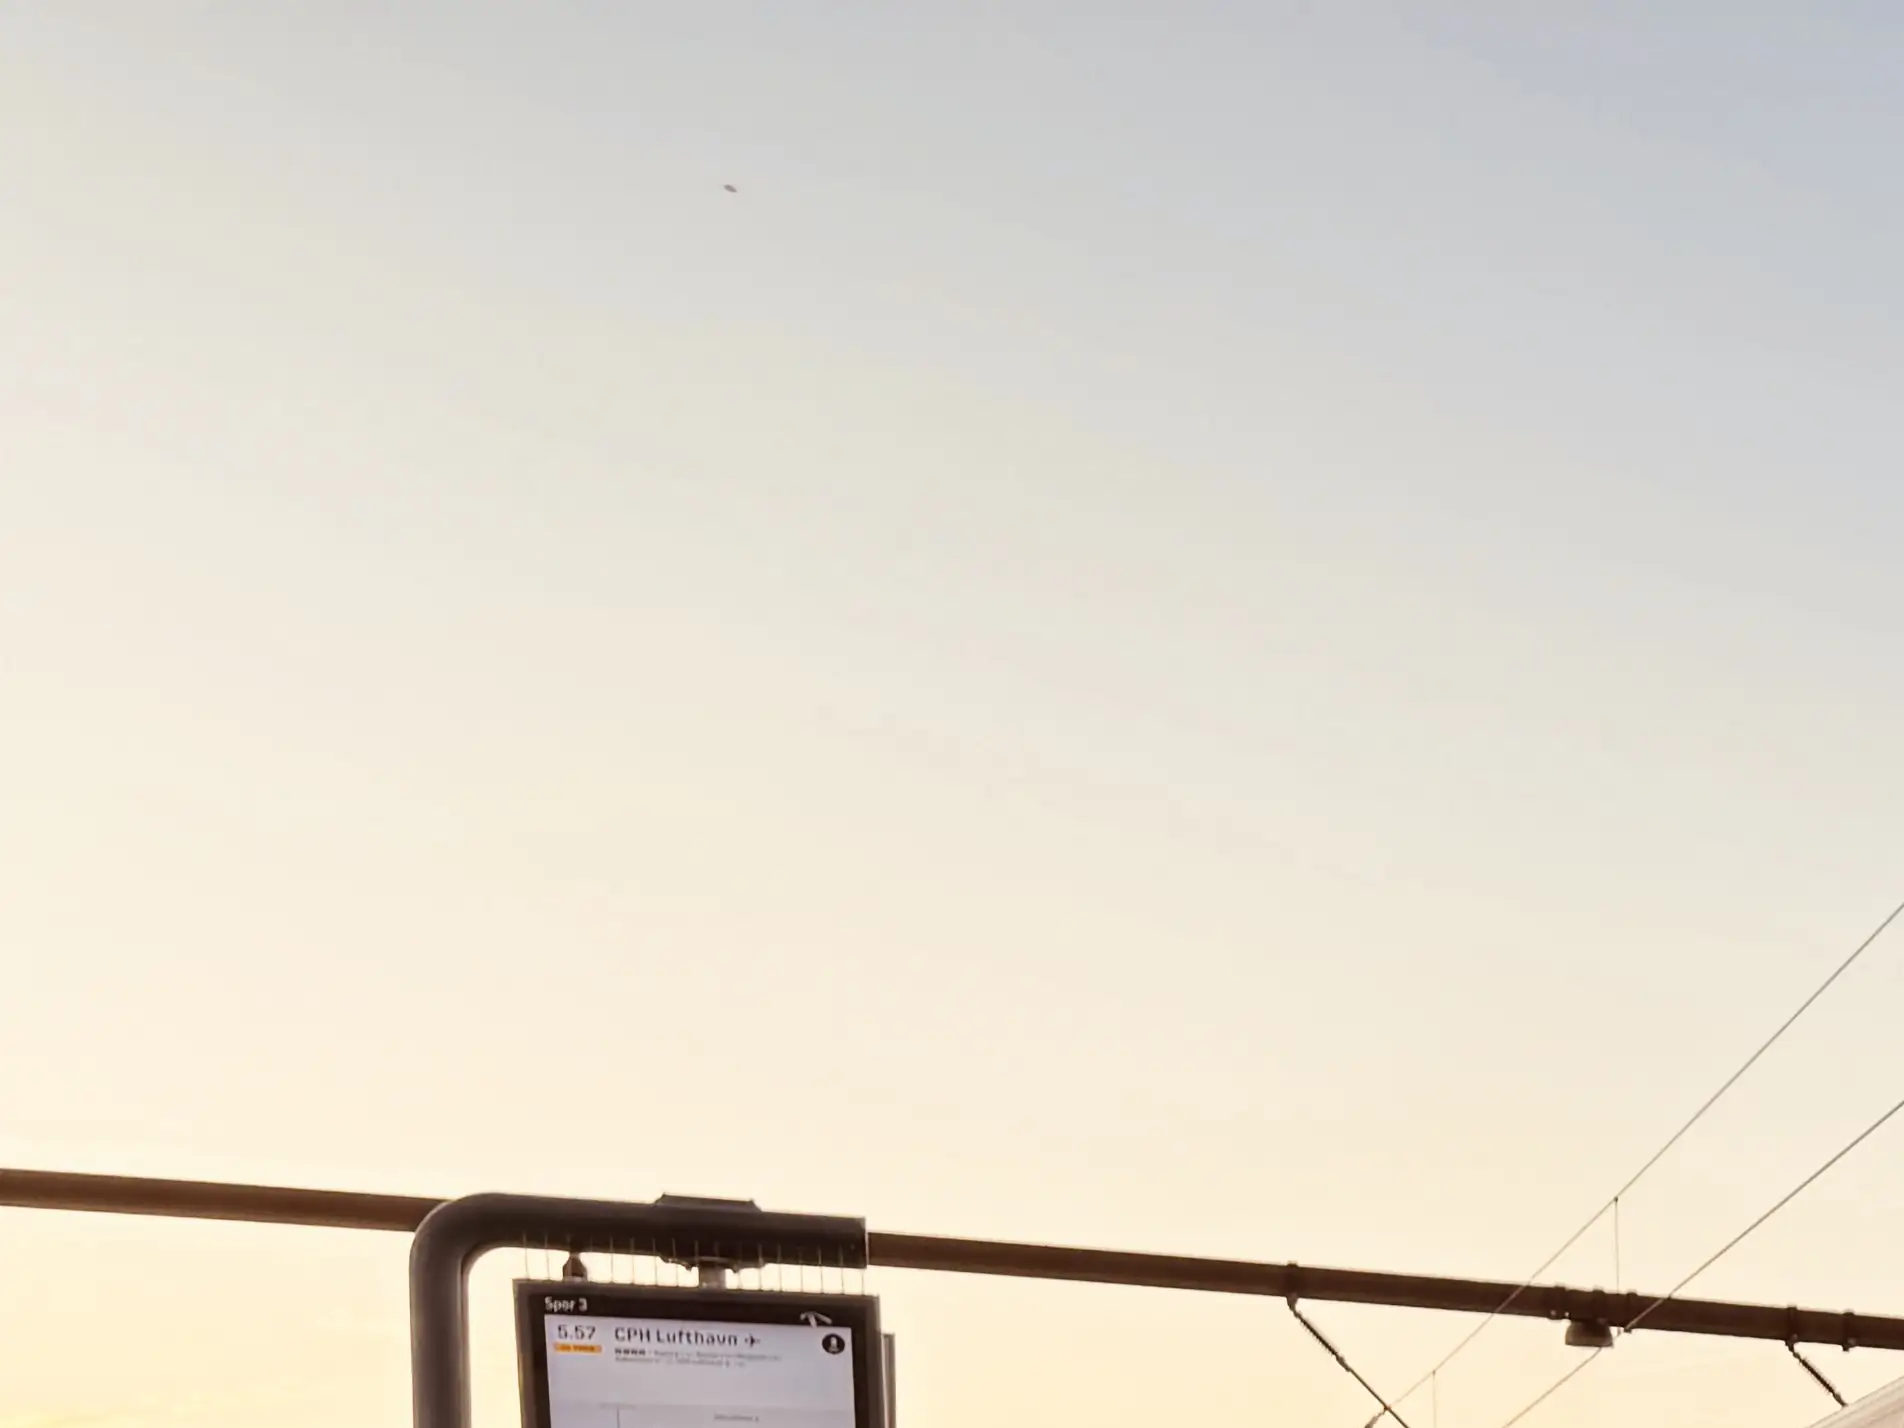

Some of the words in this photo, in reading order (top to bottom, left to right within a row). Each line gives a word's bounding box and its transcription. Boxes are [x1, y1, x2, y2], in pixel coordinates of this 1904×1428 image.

[558, 1324, 596, 1340] 5.57
[614, 1326, 651, 1343] CPH
[656, 1328, 738, 1347] Lufthavn
